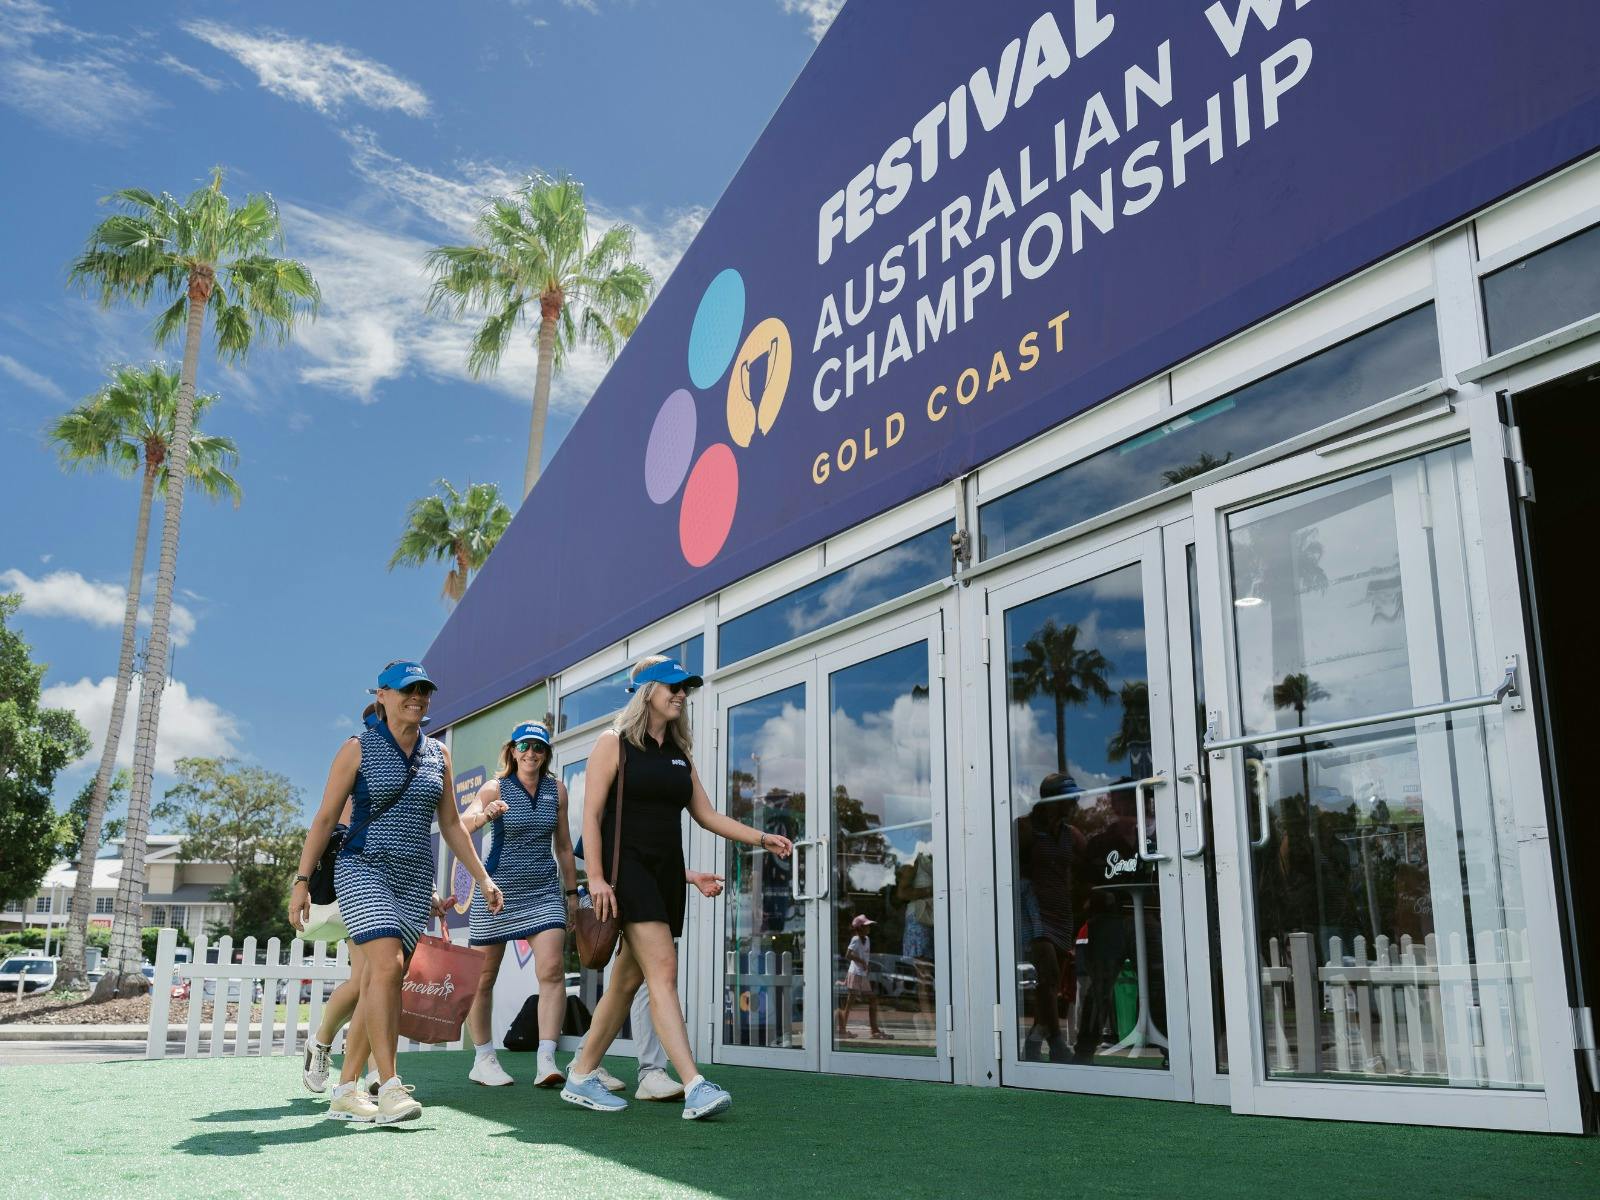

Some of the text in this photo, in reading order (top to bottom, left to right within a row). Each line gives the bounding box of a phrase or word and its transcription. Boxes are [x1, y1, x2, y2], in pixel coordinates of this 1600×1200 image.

[812, 0, 1313, 354] AUSTRALIAN W
[812, 37, 1313, 412] CHAMPIONSHIP
[817, 0, 1115, 265] FESTIVAL
[812, 310, 1070, 485] GOLD COAST
